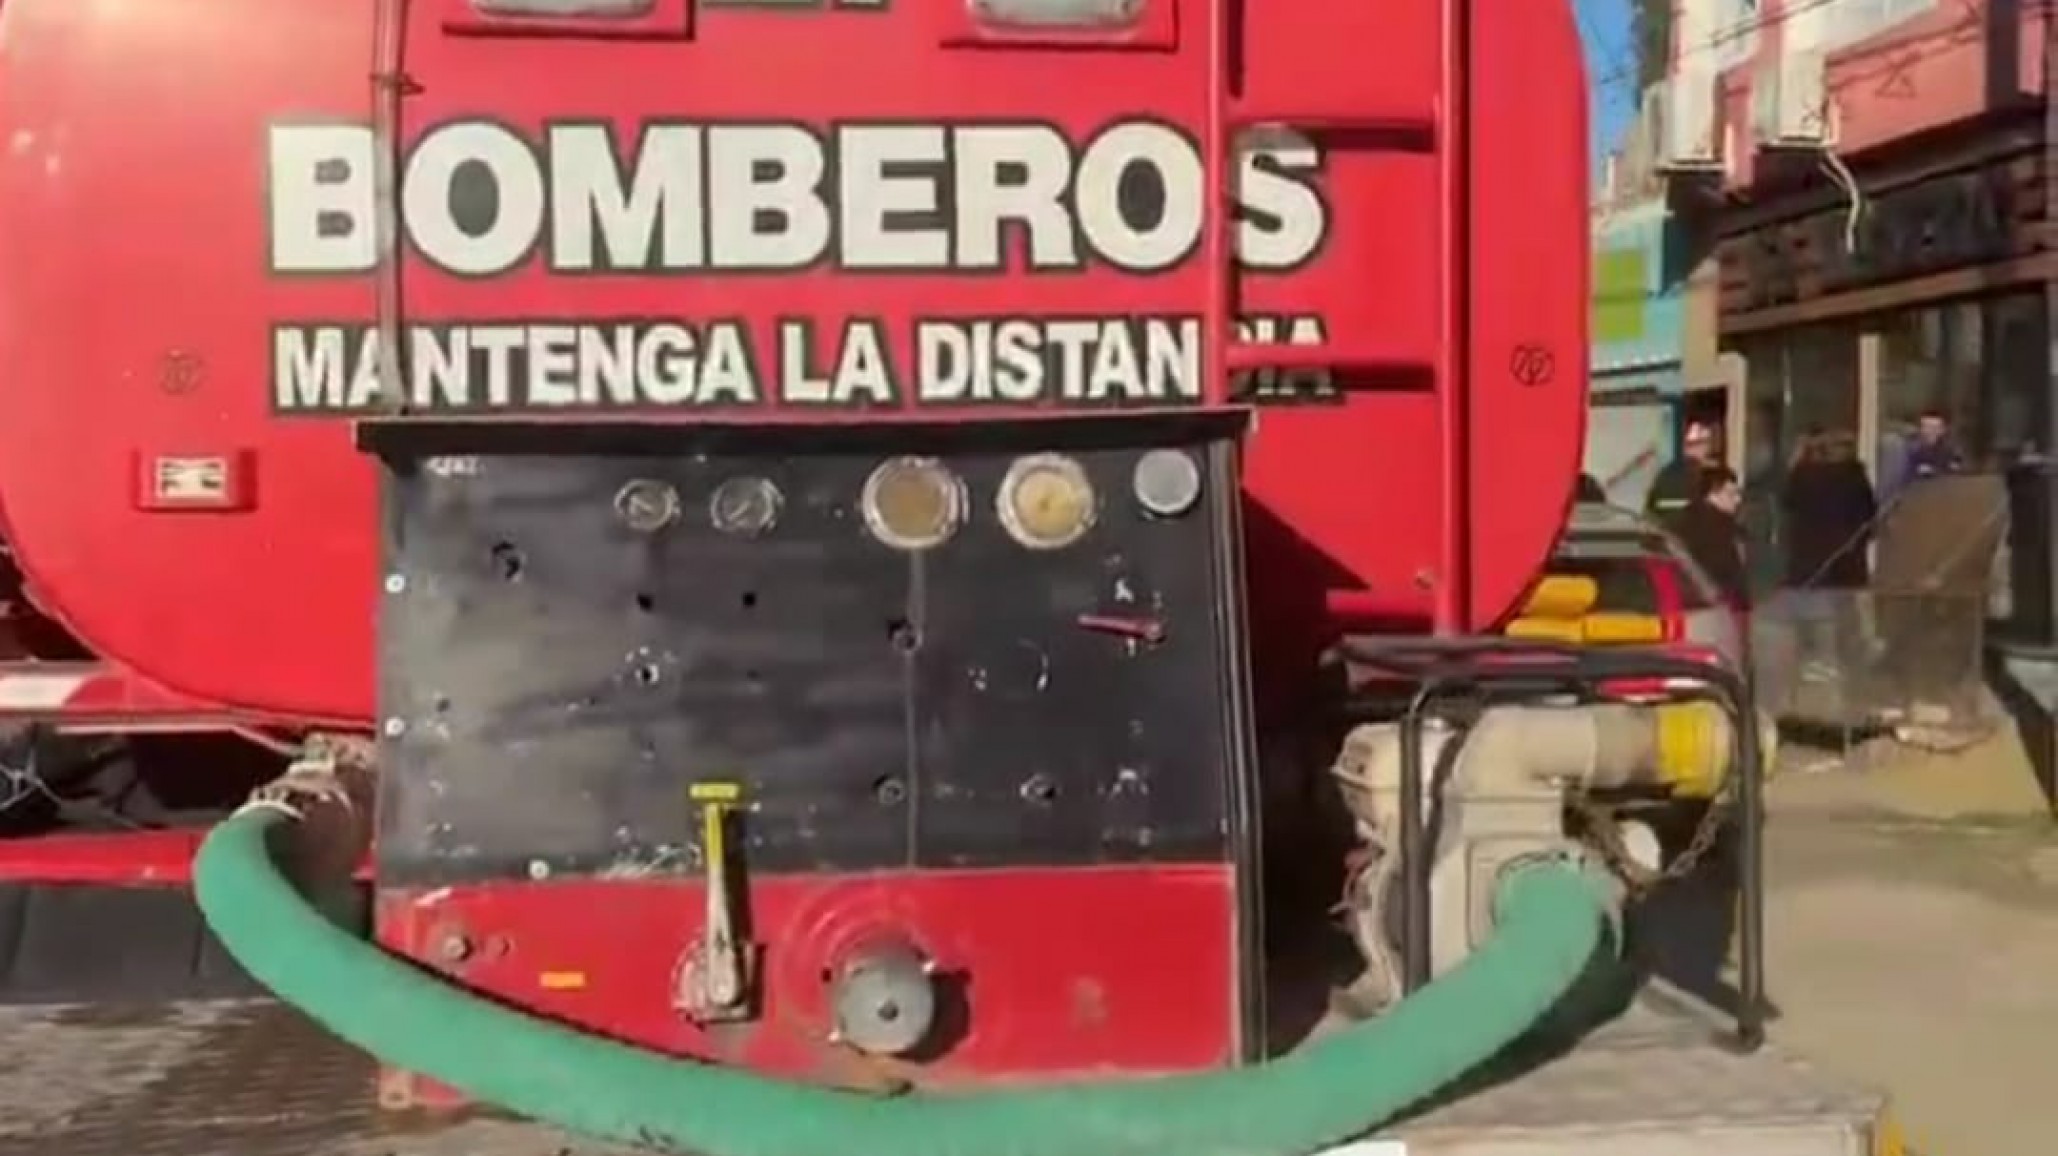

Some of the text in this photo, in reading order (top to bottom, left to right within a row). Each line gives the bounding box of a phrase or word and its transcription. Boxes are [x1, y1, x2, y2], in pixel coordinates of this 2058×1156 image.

[268, 120, 1326, 274] BOMBEROS
[273, 322, 756, 409] MANTENGA
[781, 321, 892, 404] LA
